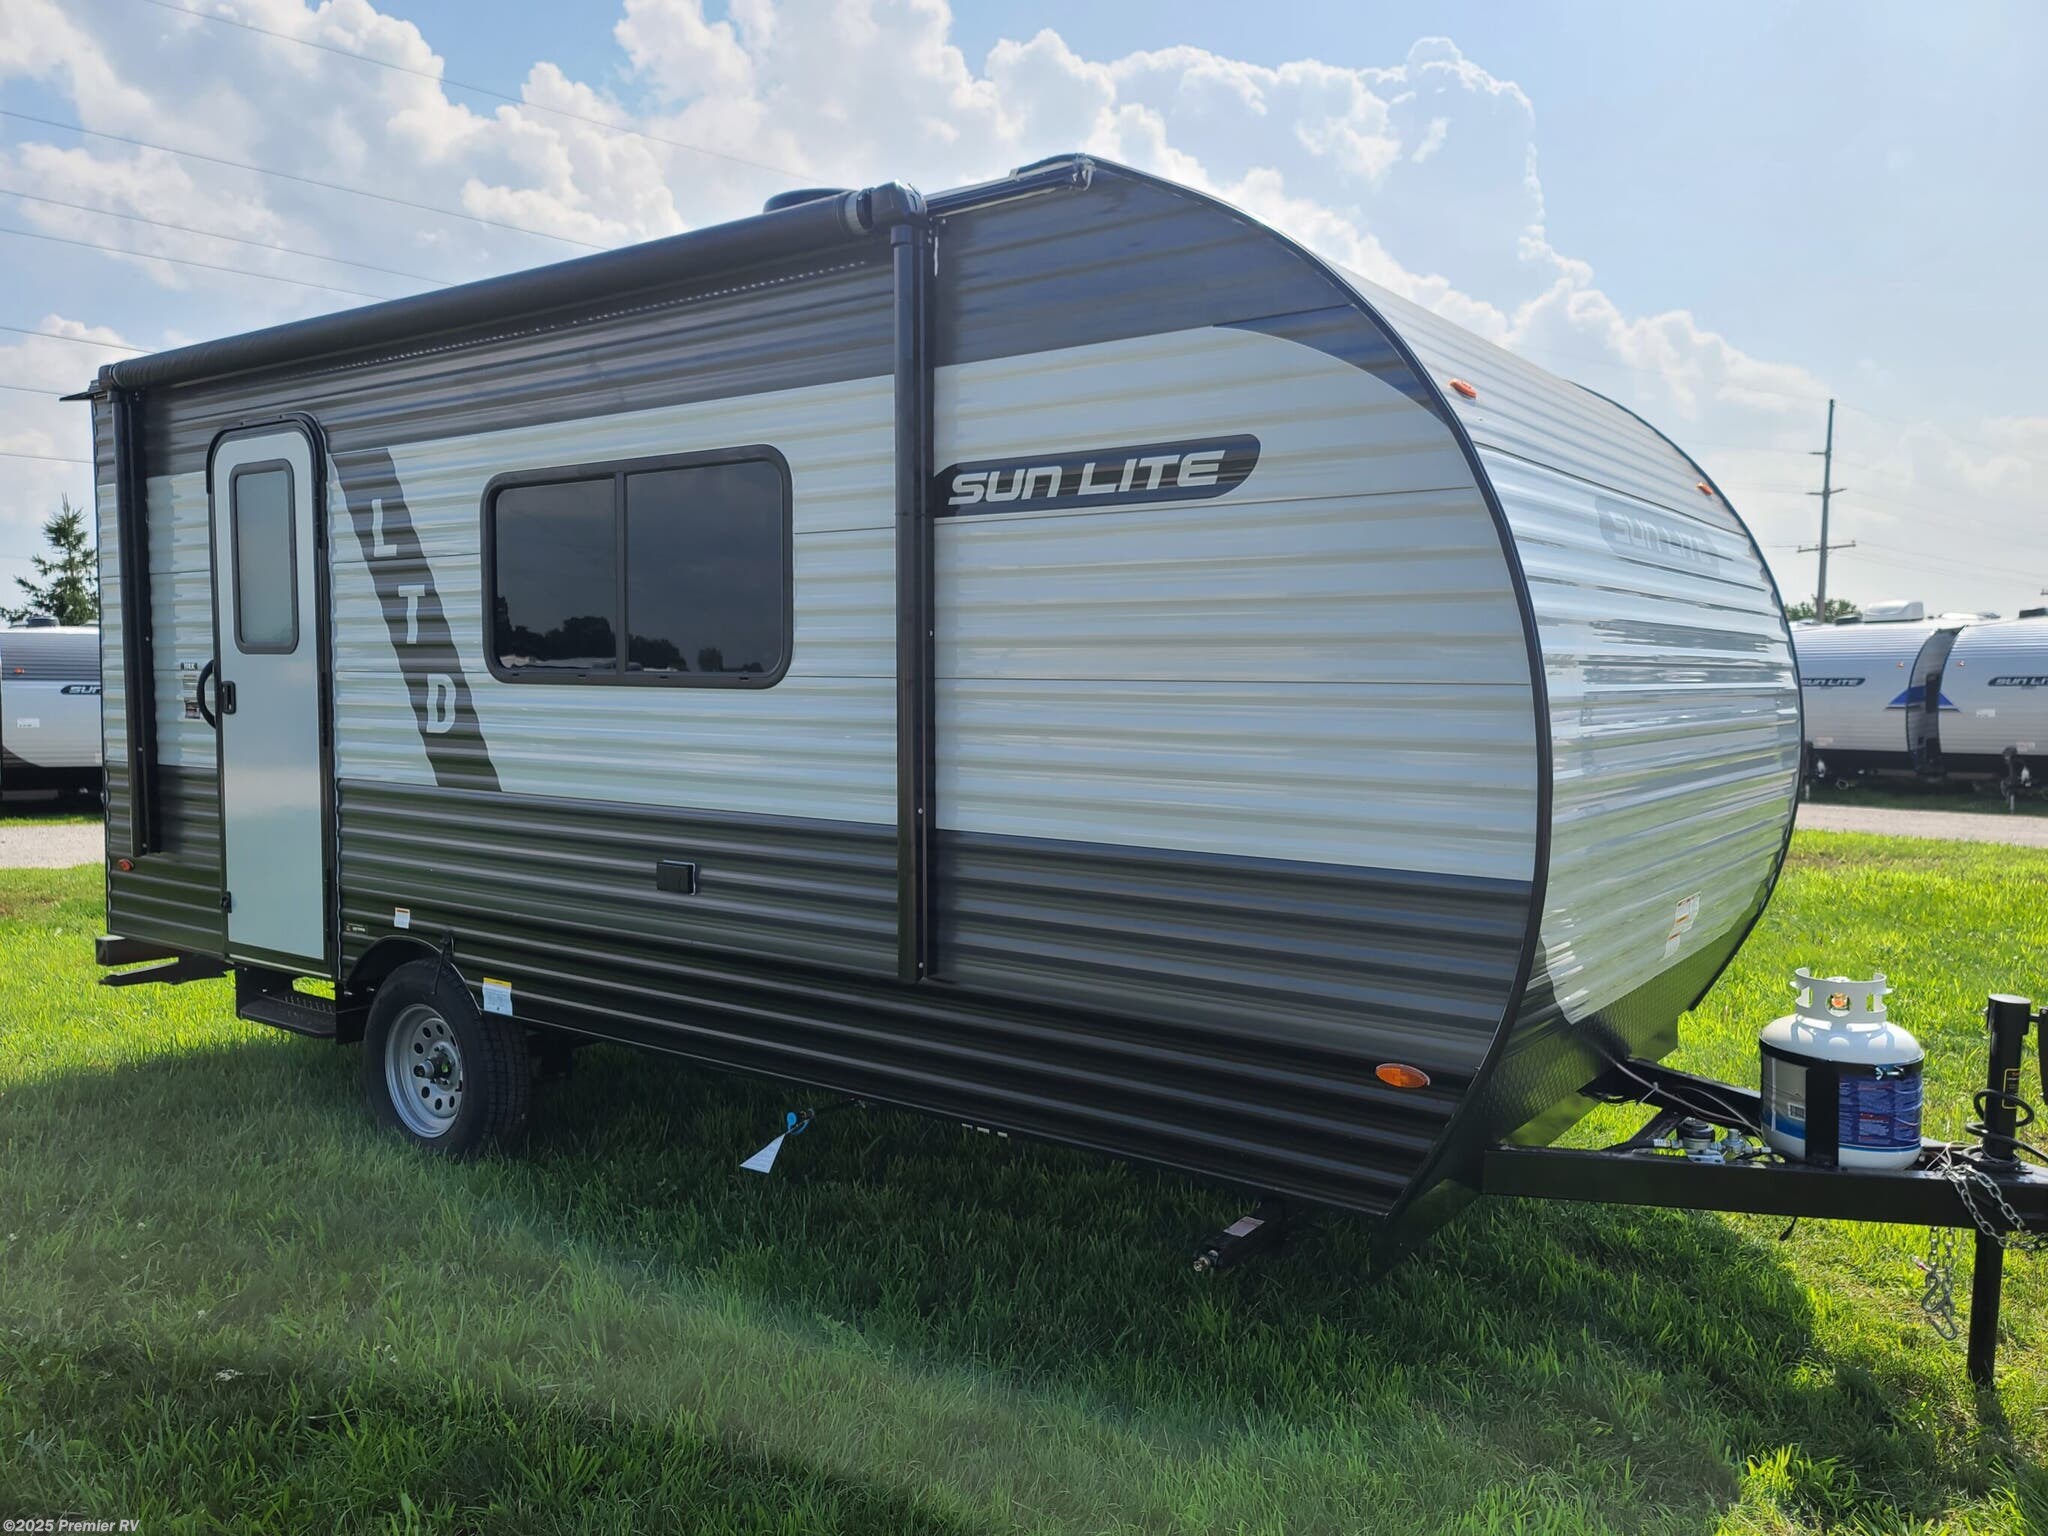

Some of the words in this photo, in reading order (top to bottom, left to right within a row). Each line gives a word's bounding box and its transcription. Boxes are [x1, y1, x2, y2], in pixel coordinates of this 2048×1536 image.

[948, 466, 1063, 506] SUN
[1078, 449, 1226, 496] LITE
[371, 498, 457, 734] LTD
